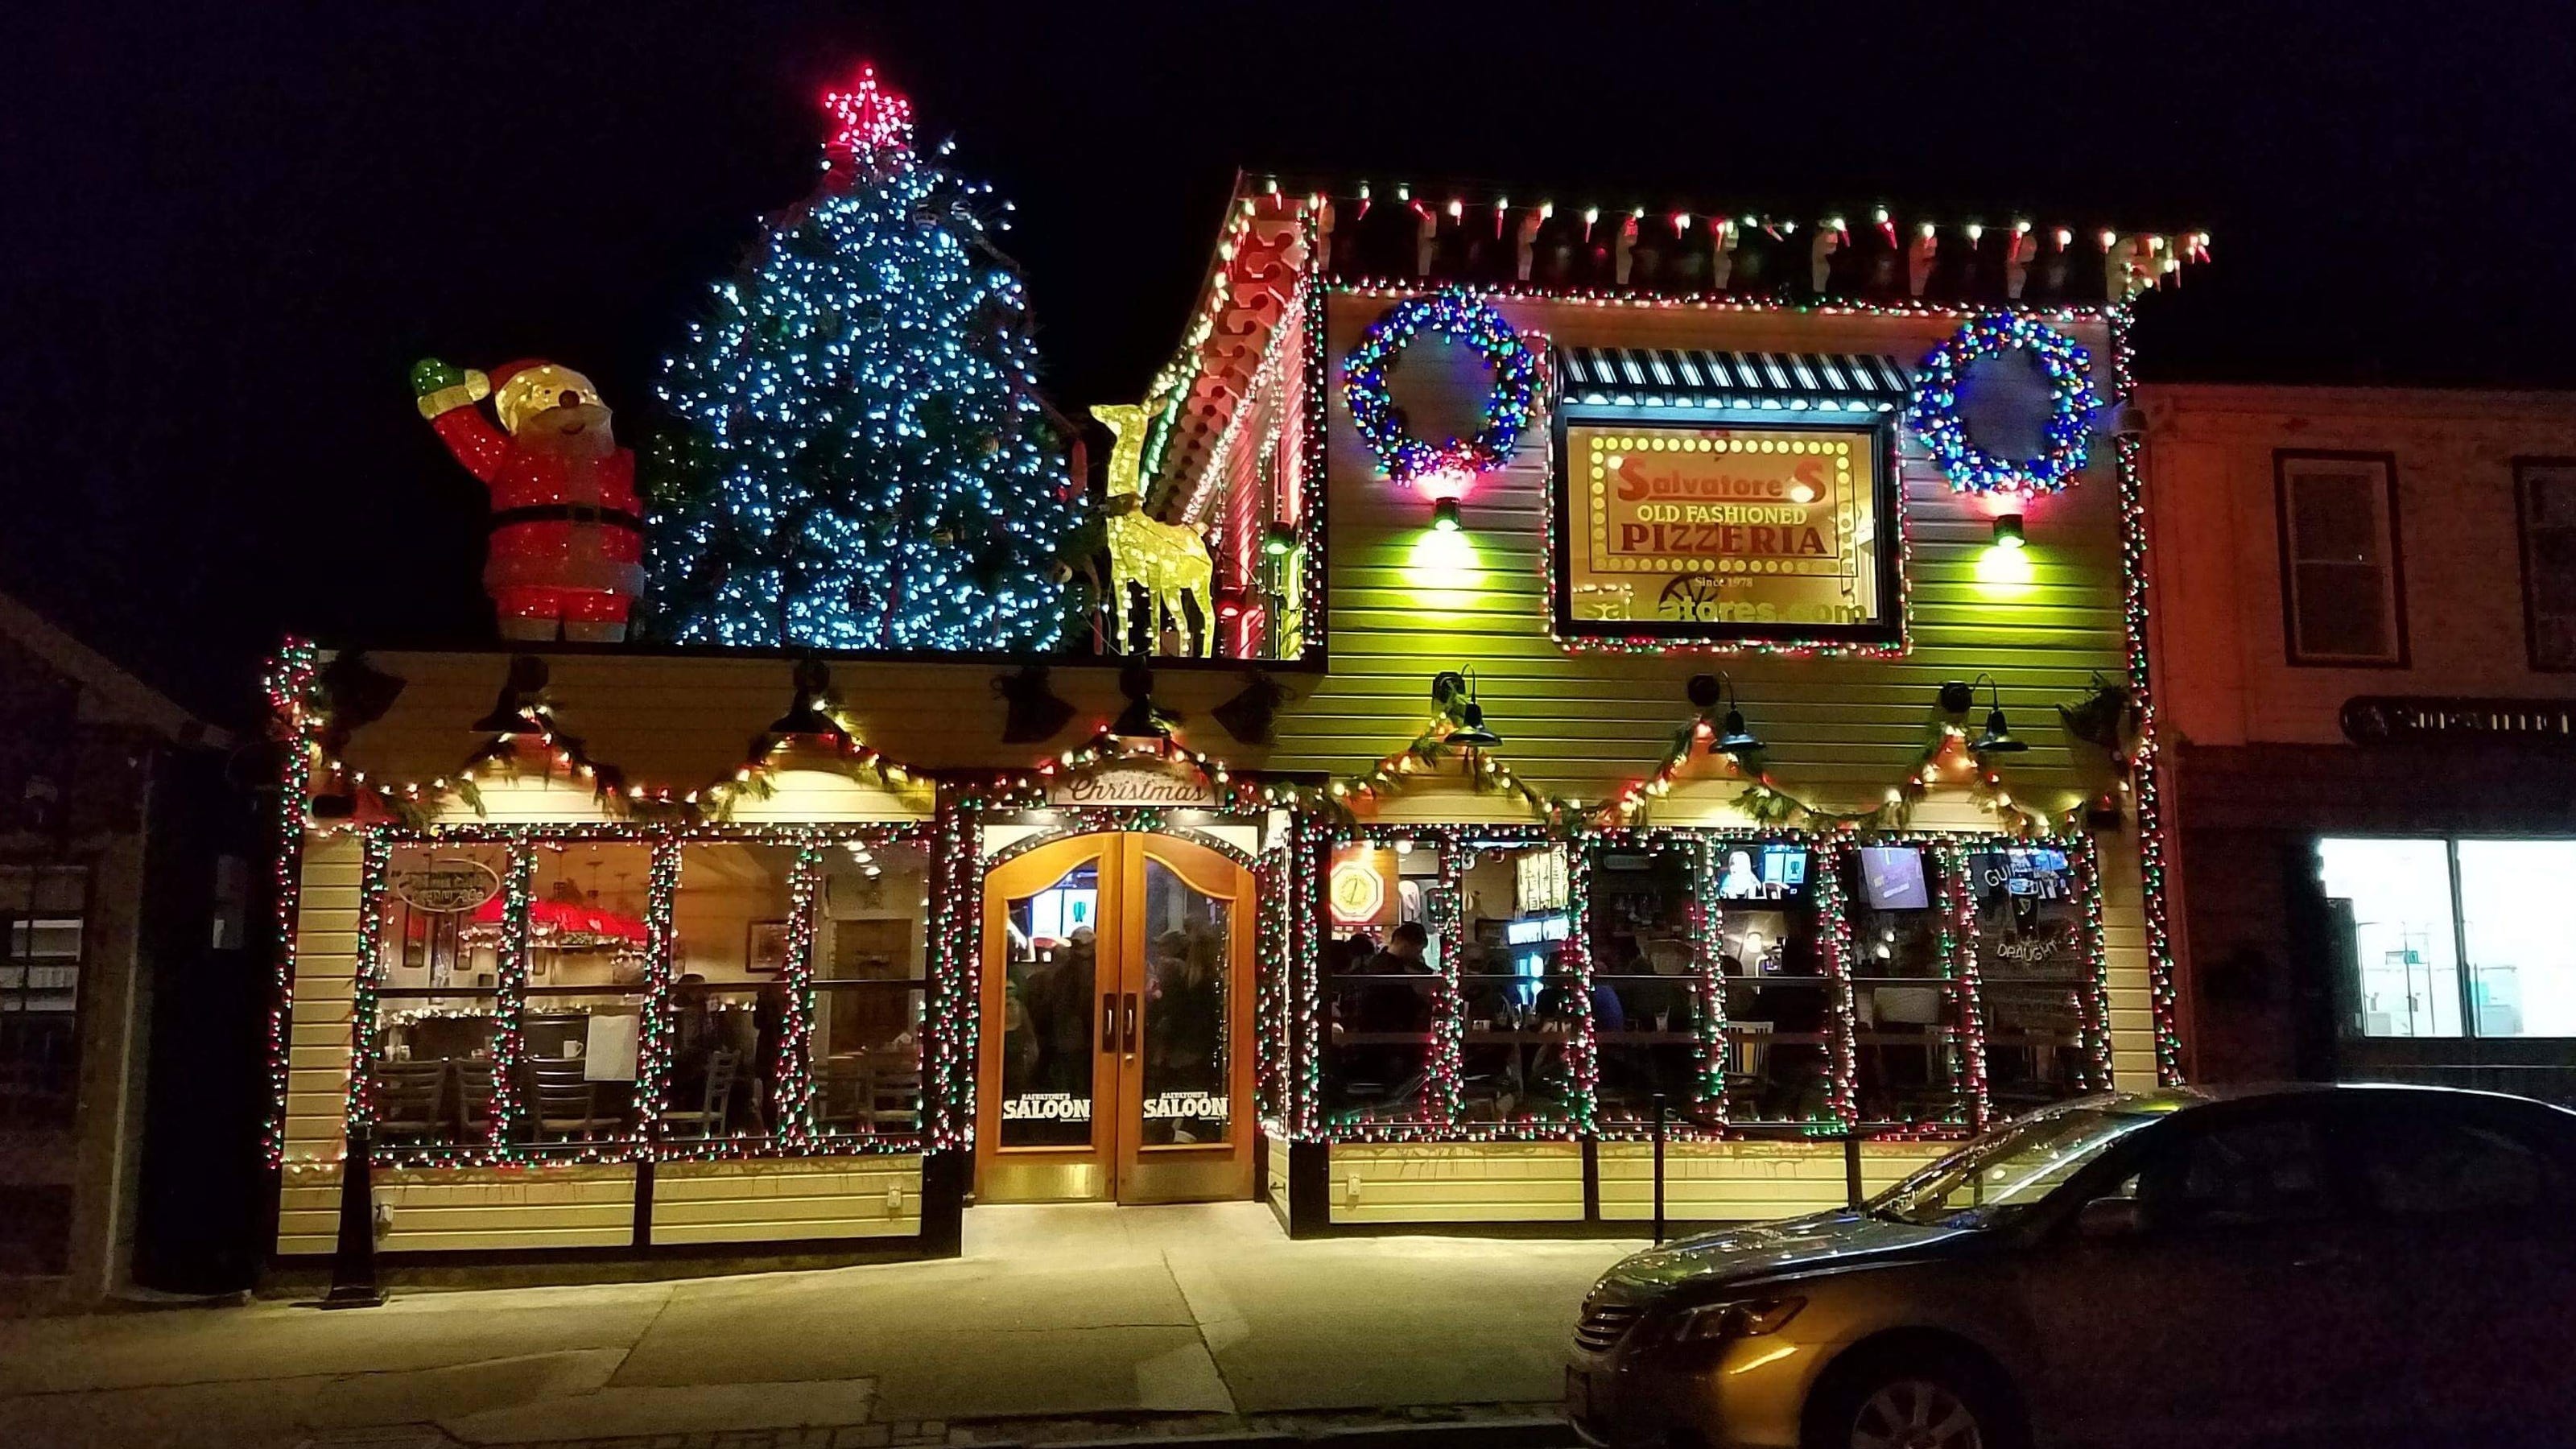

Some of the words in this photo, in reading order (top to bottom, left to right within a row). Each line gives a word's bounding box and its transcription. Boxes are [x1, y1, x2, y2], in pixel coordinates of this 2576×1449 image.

[1637, 505, 1680, 522] OLD
[1686, 506, 1808, 525] FASHIONED
[1620, 522, 1828, 555] PIZZERIA
[1695, 576, 1724, 588] Since
[1727, 577, 1753, 588] 1978
[1069, 778, 1208, 802] Christmas
[1996, 940, 2058, 961] DRAUGHT
[1002, 1099, 1091, 1120] SALOON
[1142, 1097, 1229, 1118] SALOON
